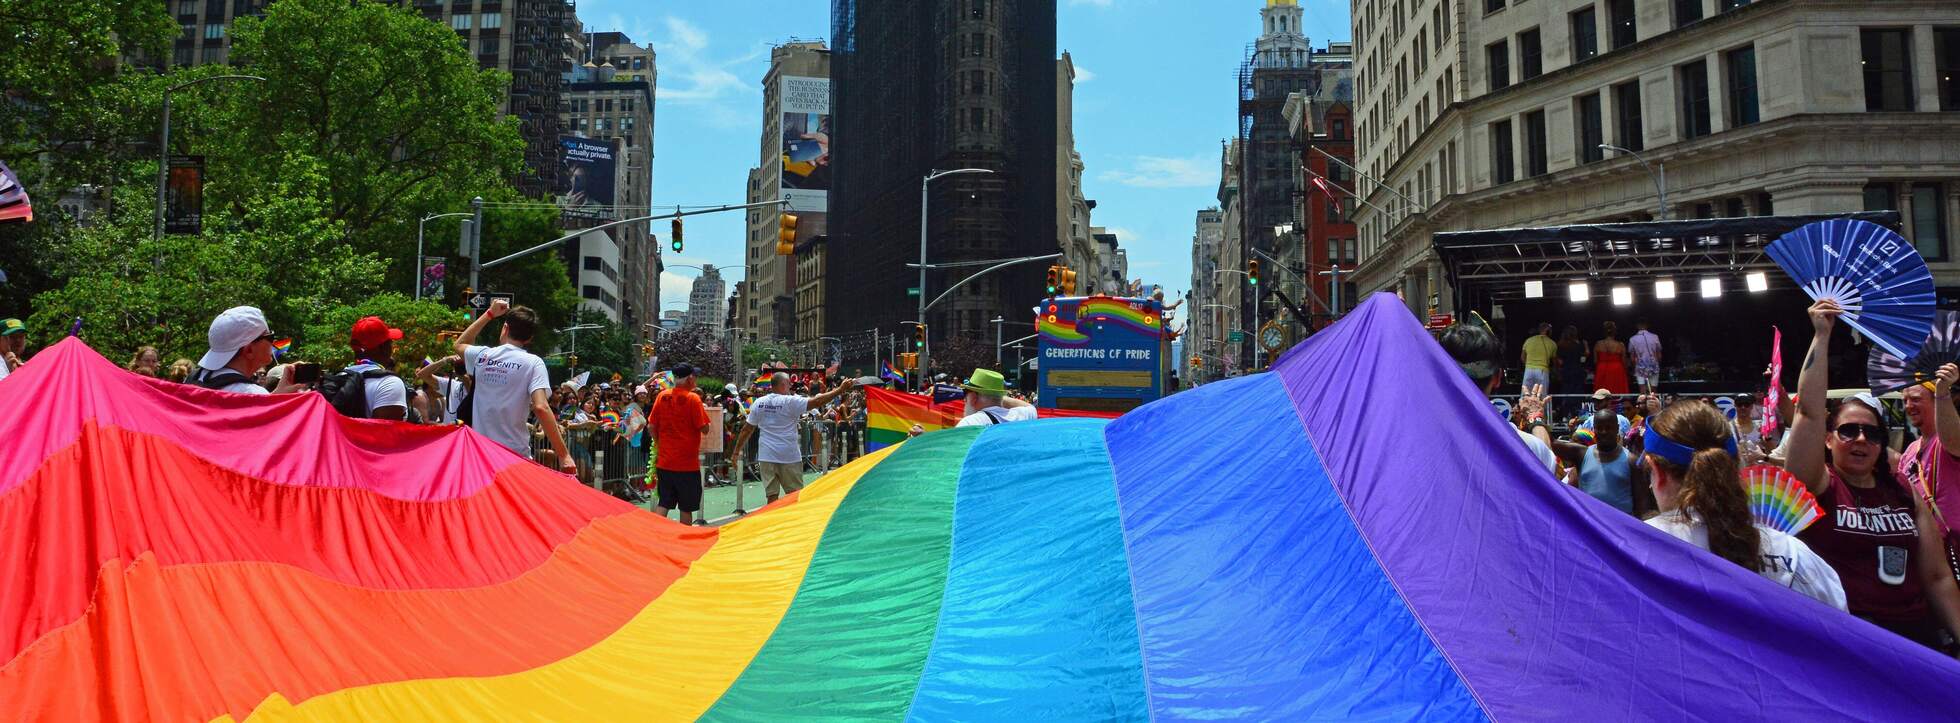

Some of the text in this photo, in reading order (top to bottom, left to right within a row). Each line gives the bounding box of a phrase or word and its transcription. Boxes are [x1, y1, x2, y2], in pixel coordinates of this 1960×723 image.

[584, 143, 608, 152] browser
[1045, 348, 1151, 359] GENERATIONS OF PRIDE
[487, 359, 522, 371] DIGNITY
